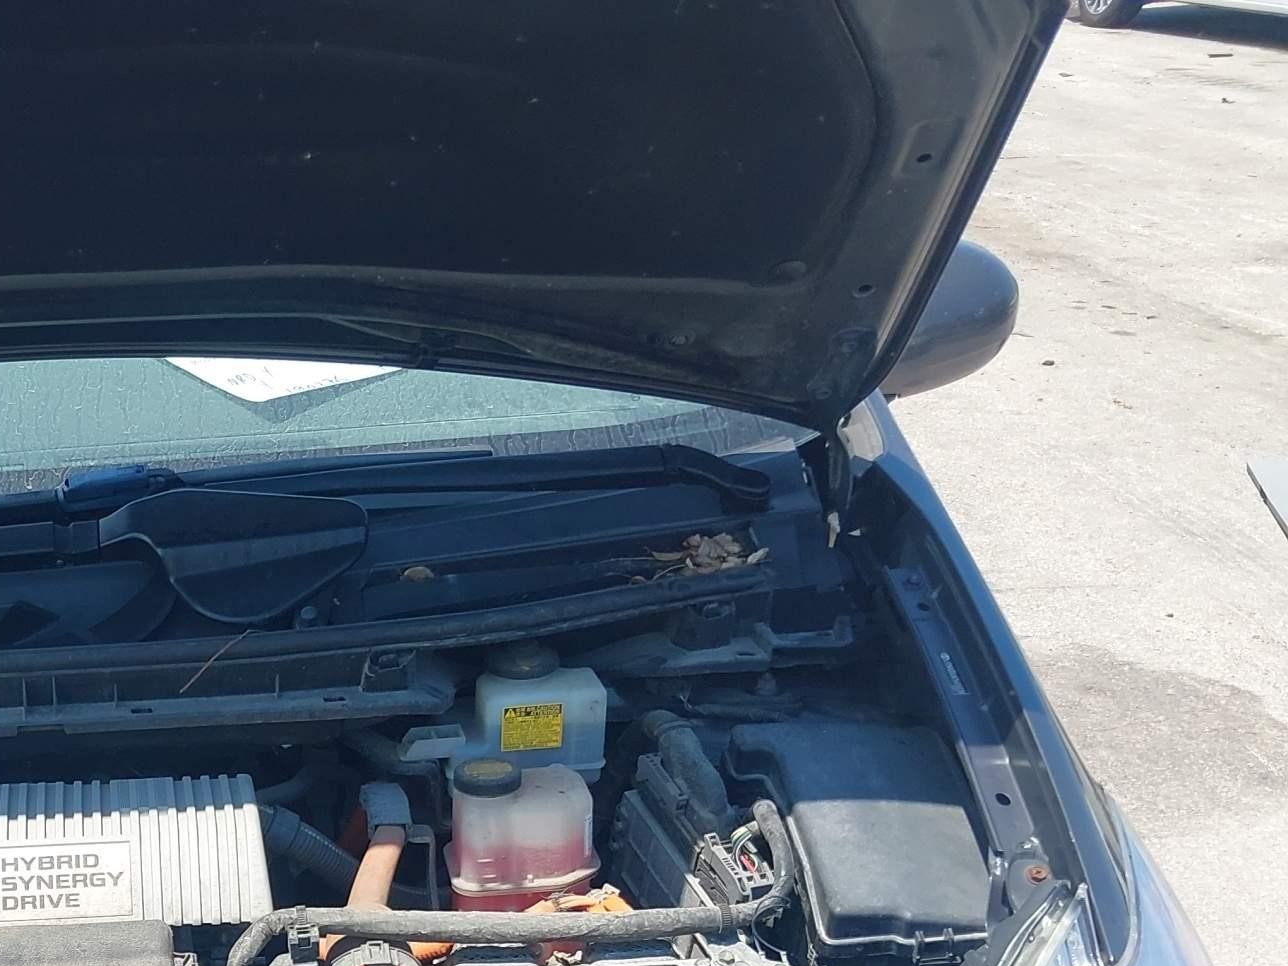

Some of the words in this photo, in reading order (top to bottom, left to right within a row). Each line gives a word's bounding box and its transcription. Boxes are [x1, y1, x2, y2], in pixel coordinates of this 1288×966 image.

[1, 854, 100, 872] HYBRID
[1, 871, 124, 892] SYNERGY
[2, 893, 81, 911] DRIVE
